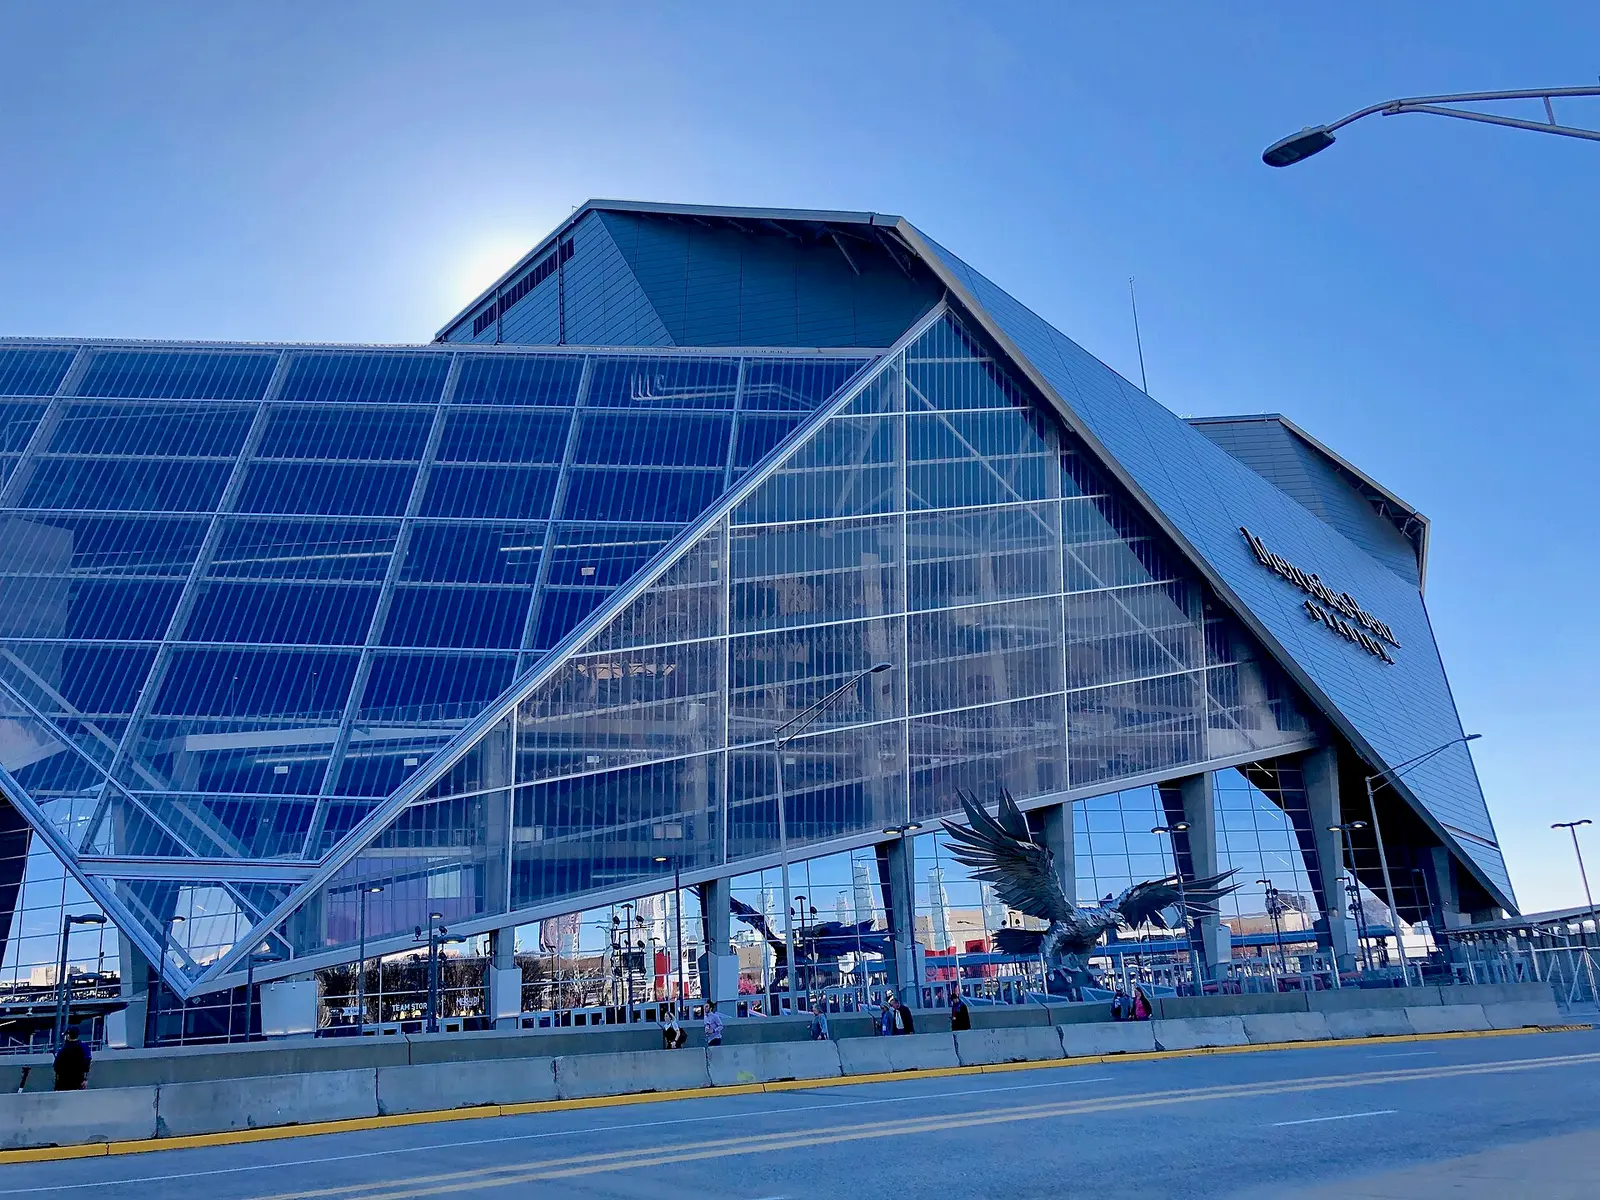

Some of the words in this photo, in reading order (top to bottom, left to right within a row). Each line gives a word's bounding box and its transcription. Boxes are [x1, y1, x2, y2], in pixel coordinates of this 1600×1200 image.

[1239, 526, 1402, 649] Mercedes-Benz
[1302, 599, 1396, 666] STADIUM
[391, 1003, 411, 1012] TEAM
[410, 1001, 428, 1011] STOR
